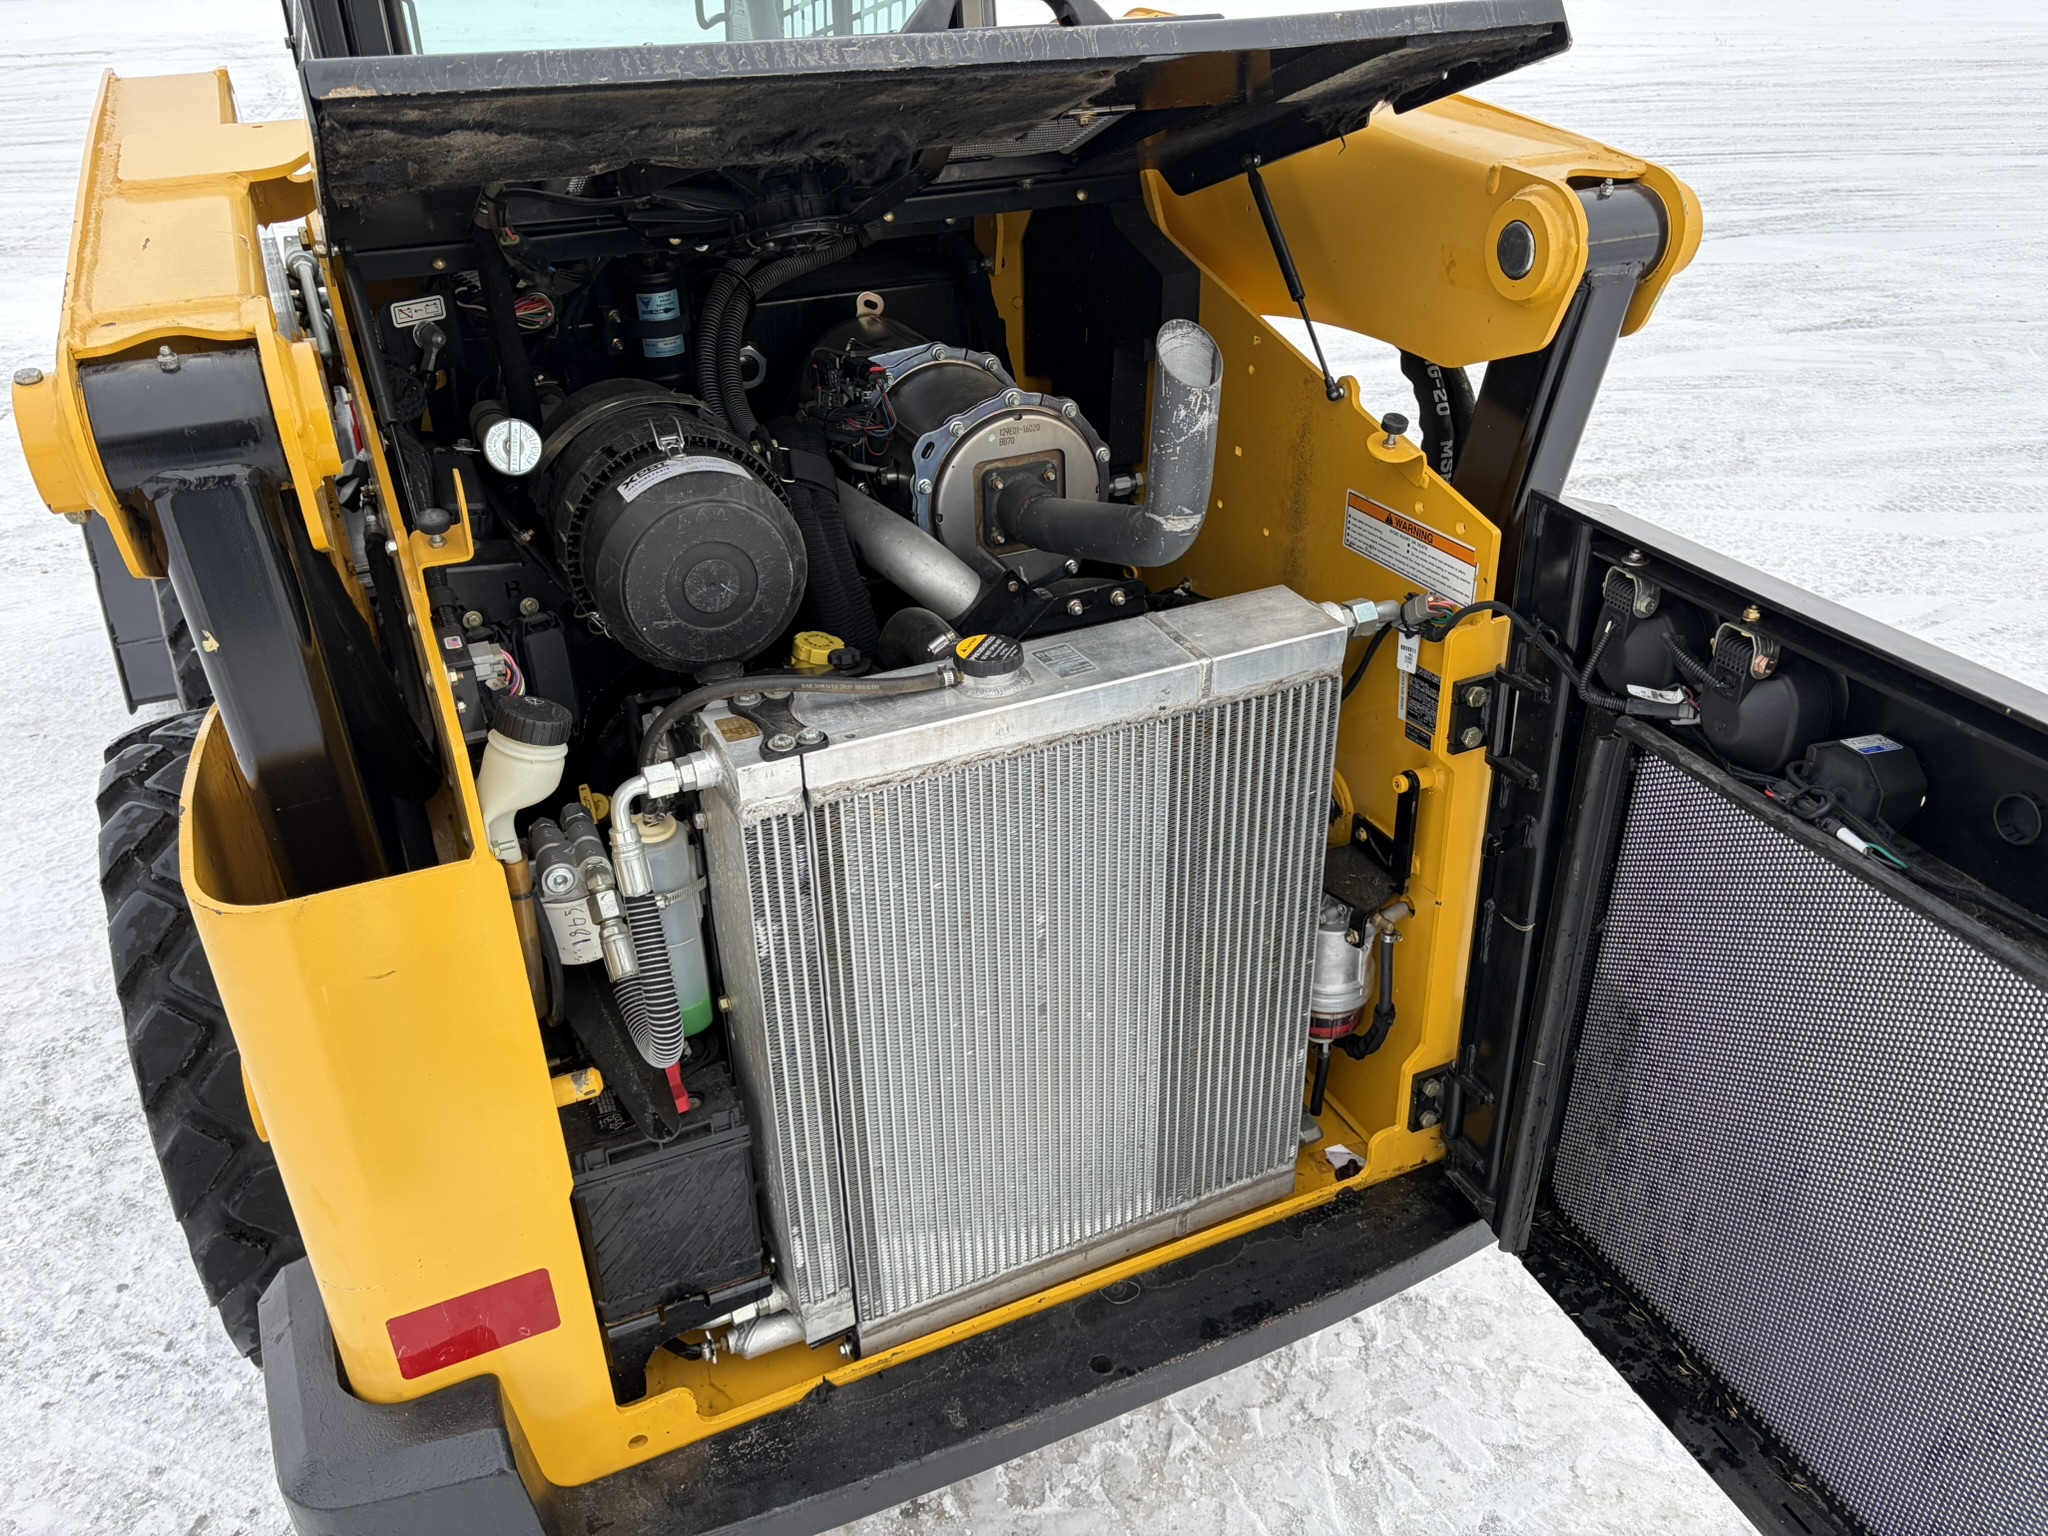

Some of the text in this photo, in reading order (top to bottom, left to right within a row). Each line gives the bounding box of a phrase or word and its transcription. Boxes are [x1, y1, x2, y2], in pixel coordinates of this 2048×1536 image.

[1425, 361, 1450, 416] G-20
[999, 424, 1041, 437] 129E01-16020
[1395, 517, 1434, 544] WARNING
[564, 907, 592, 946] 1865
